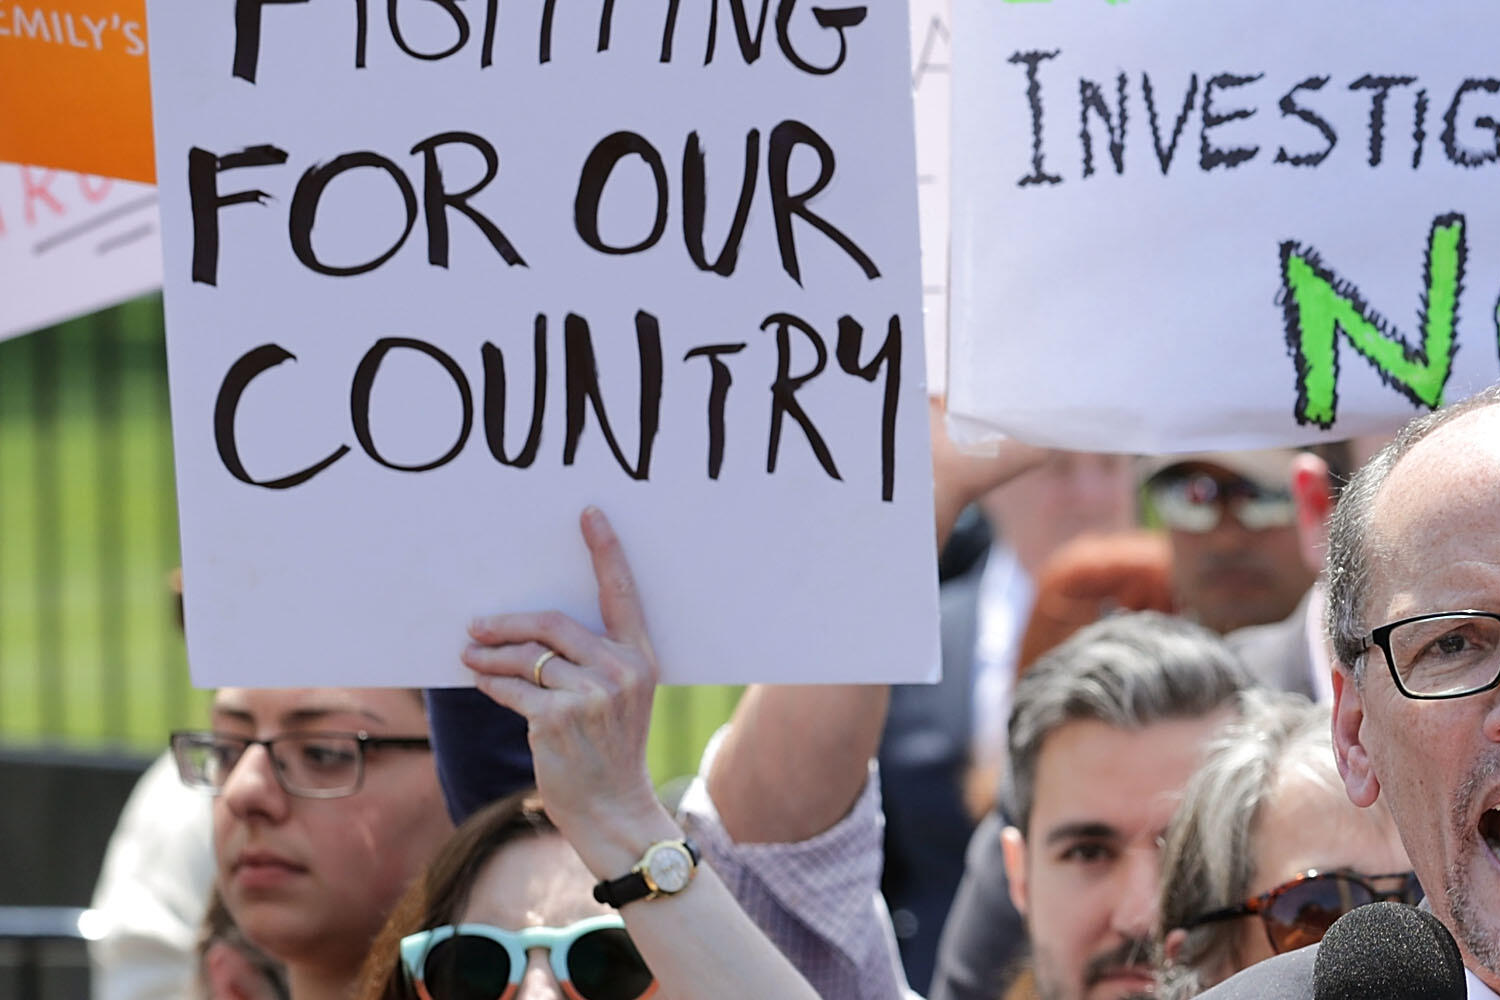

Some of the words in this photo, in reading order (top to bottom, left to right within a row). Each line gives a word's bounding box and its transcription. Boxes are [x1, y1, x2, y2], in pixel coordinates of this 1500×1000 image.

[188, 130, 529, 287] FOR
[574, 119, 882, 288] OUR
[213, 310, 903, 503] COUNTRY
